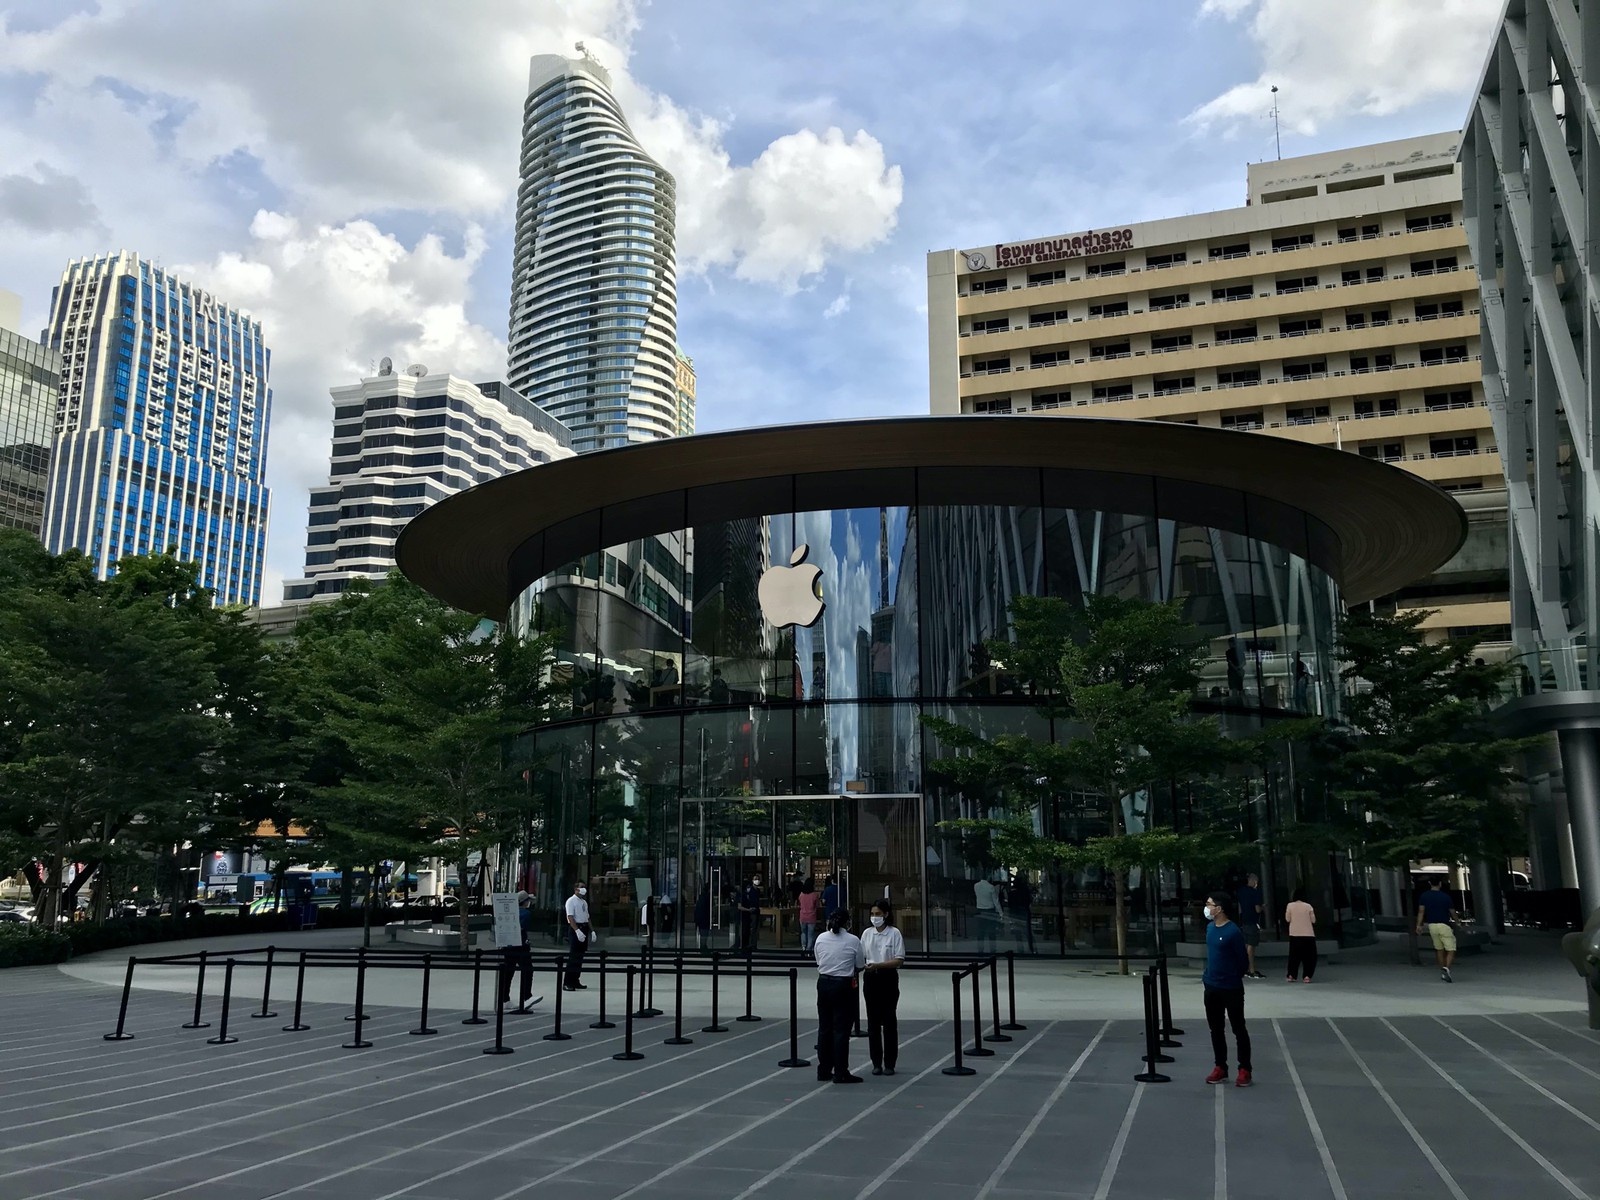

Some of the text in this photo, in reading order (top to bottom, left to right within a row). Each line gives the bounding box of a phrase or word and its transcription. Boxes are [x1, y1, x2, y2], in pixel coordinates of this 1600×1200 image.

[995, 229, 1133, 260] โรงพยาบาลตำรวจ
[996, 241, 1134, 268] POLICE GENERAL HOSPITAL
